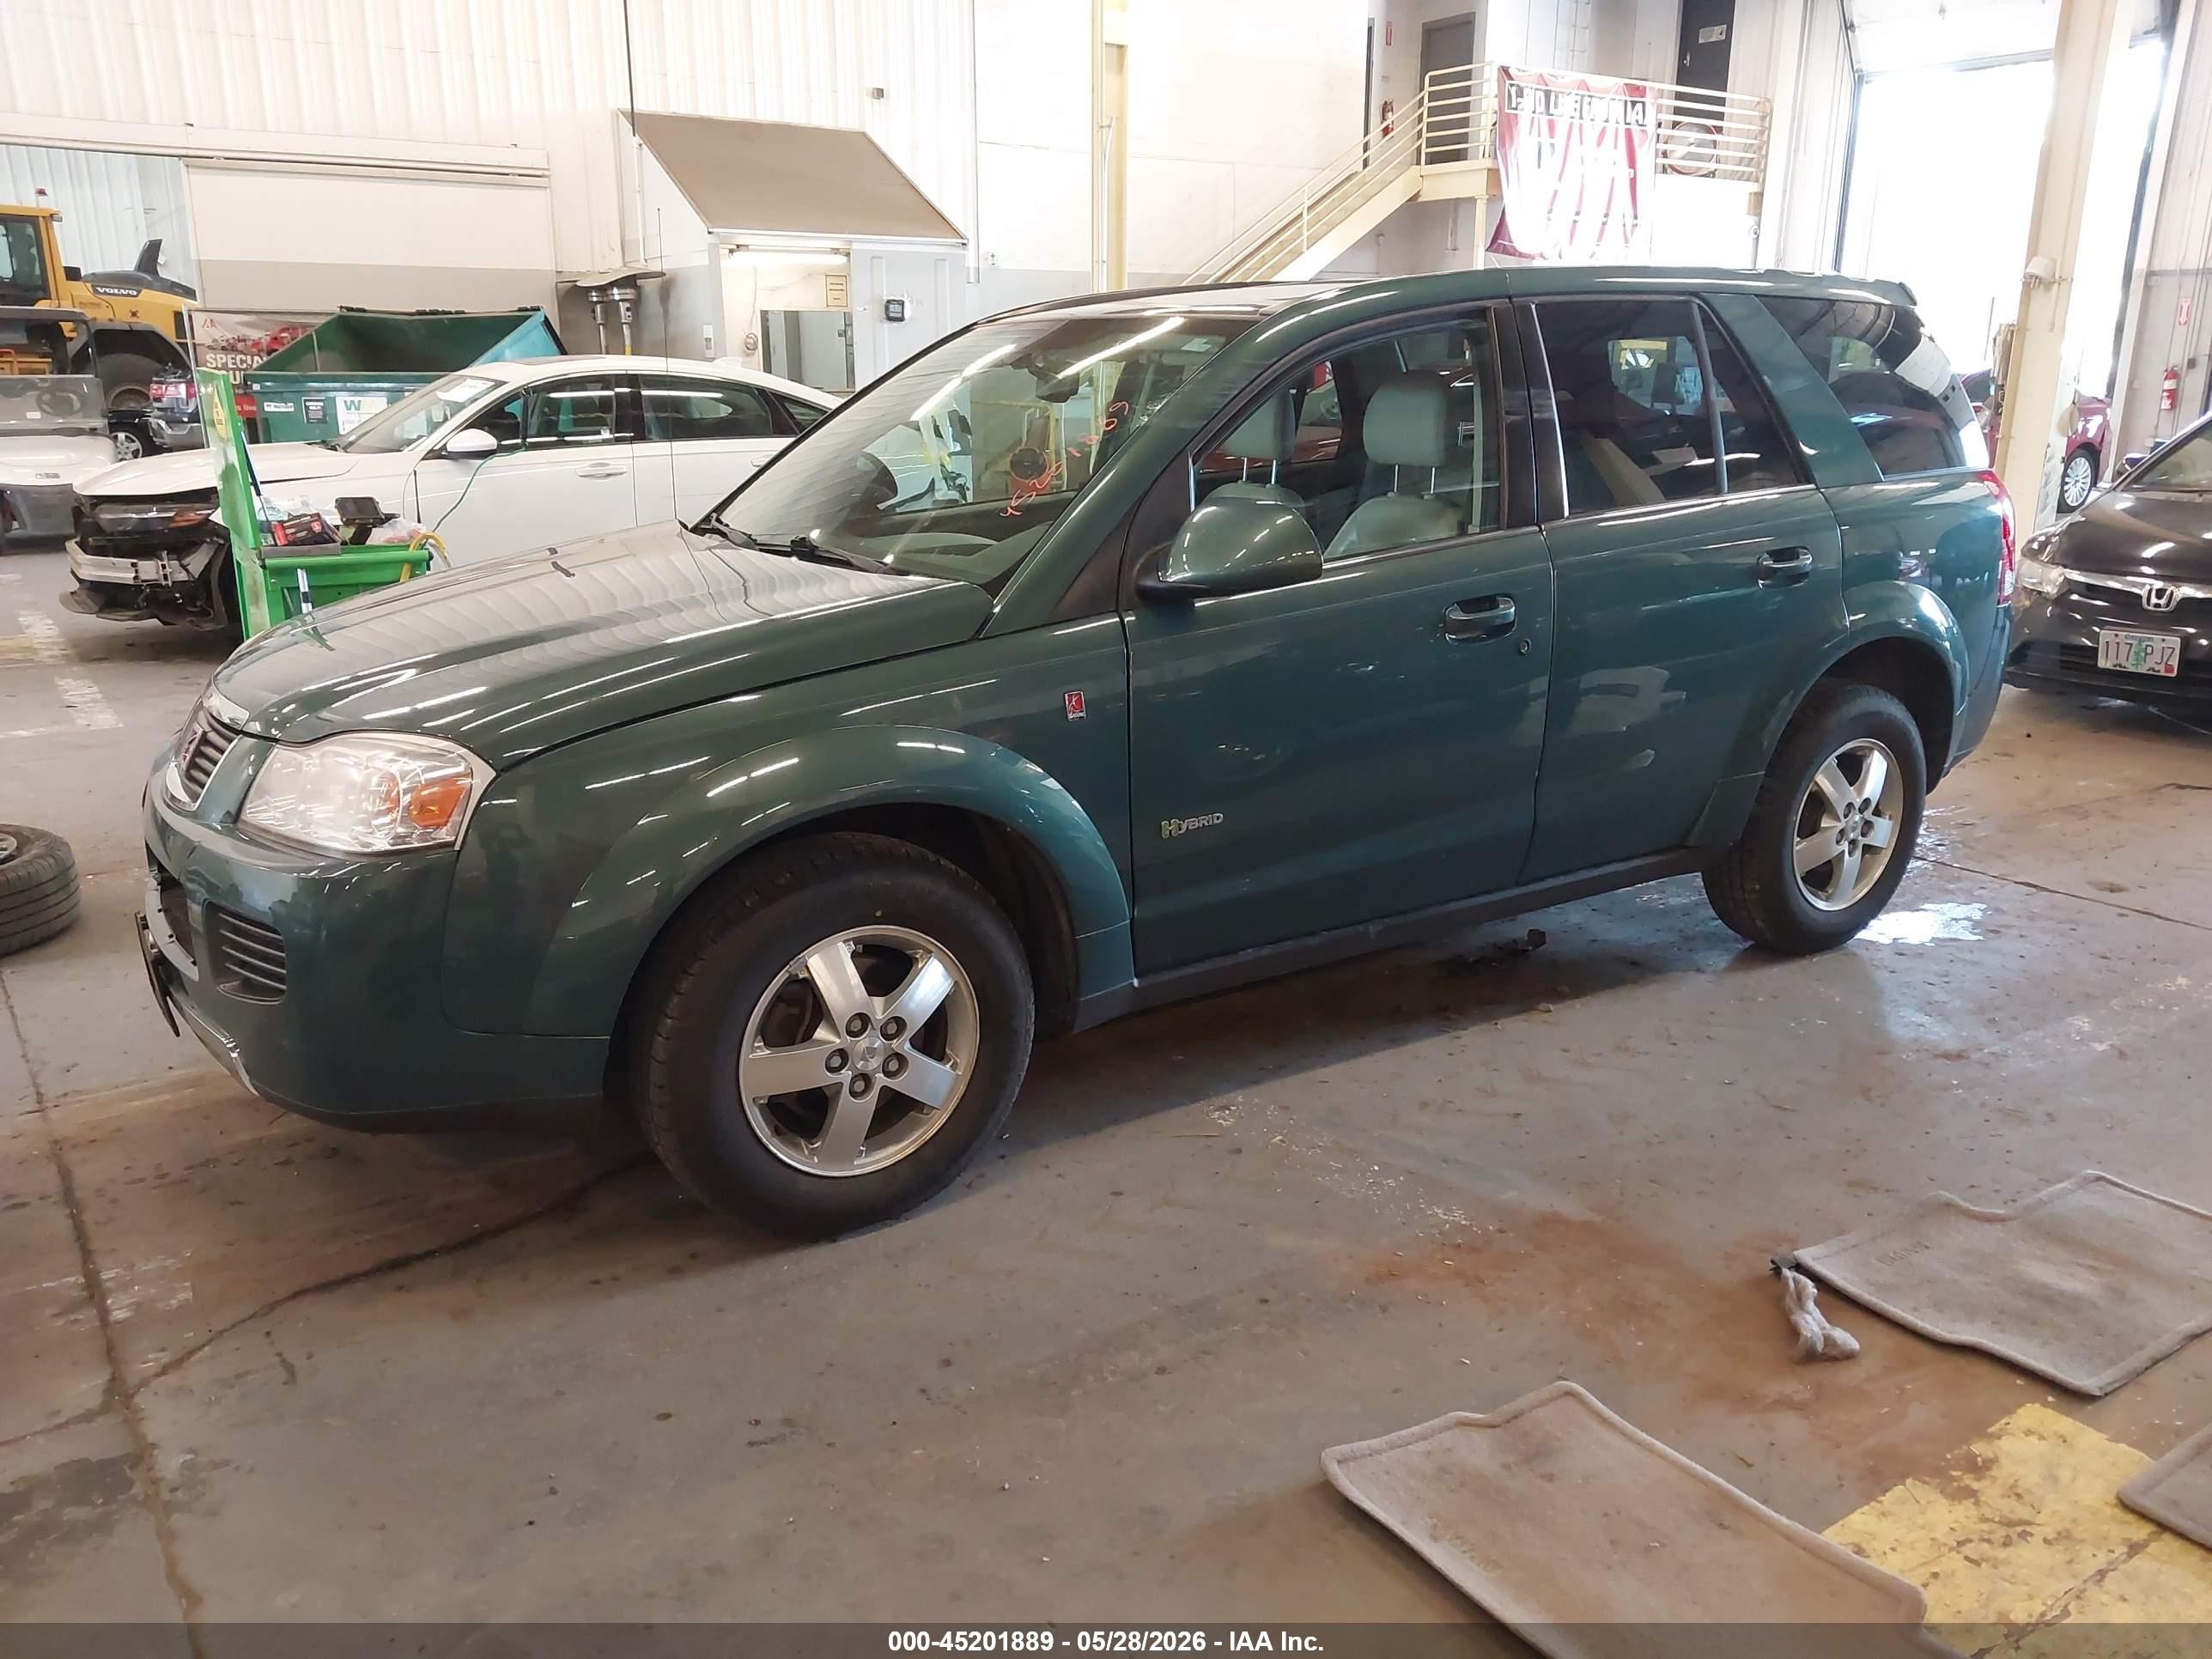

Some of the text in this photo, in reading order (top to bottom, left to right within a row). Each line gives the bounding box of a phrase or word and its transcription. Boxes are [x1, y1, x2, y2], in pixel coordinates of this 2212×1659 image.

[95, 287, 137, 295] VOLVO
[2104, 640, 2177, 666] 117 PJZ
